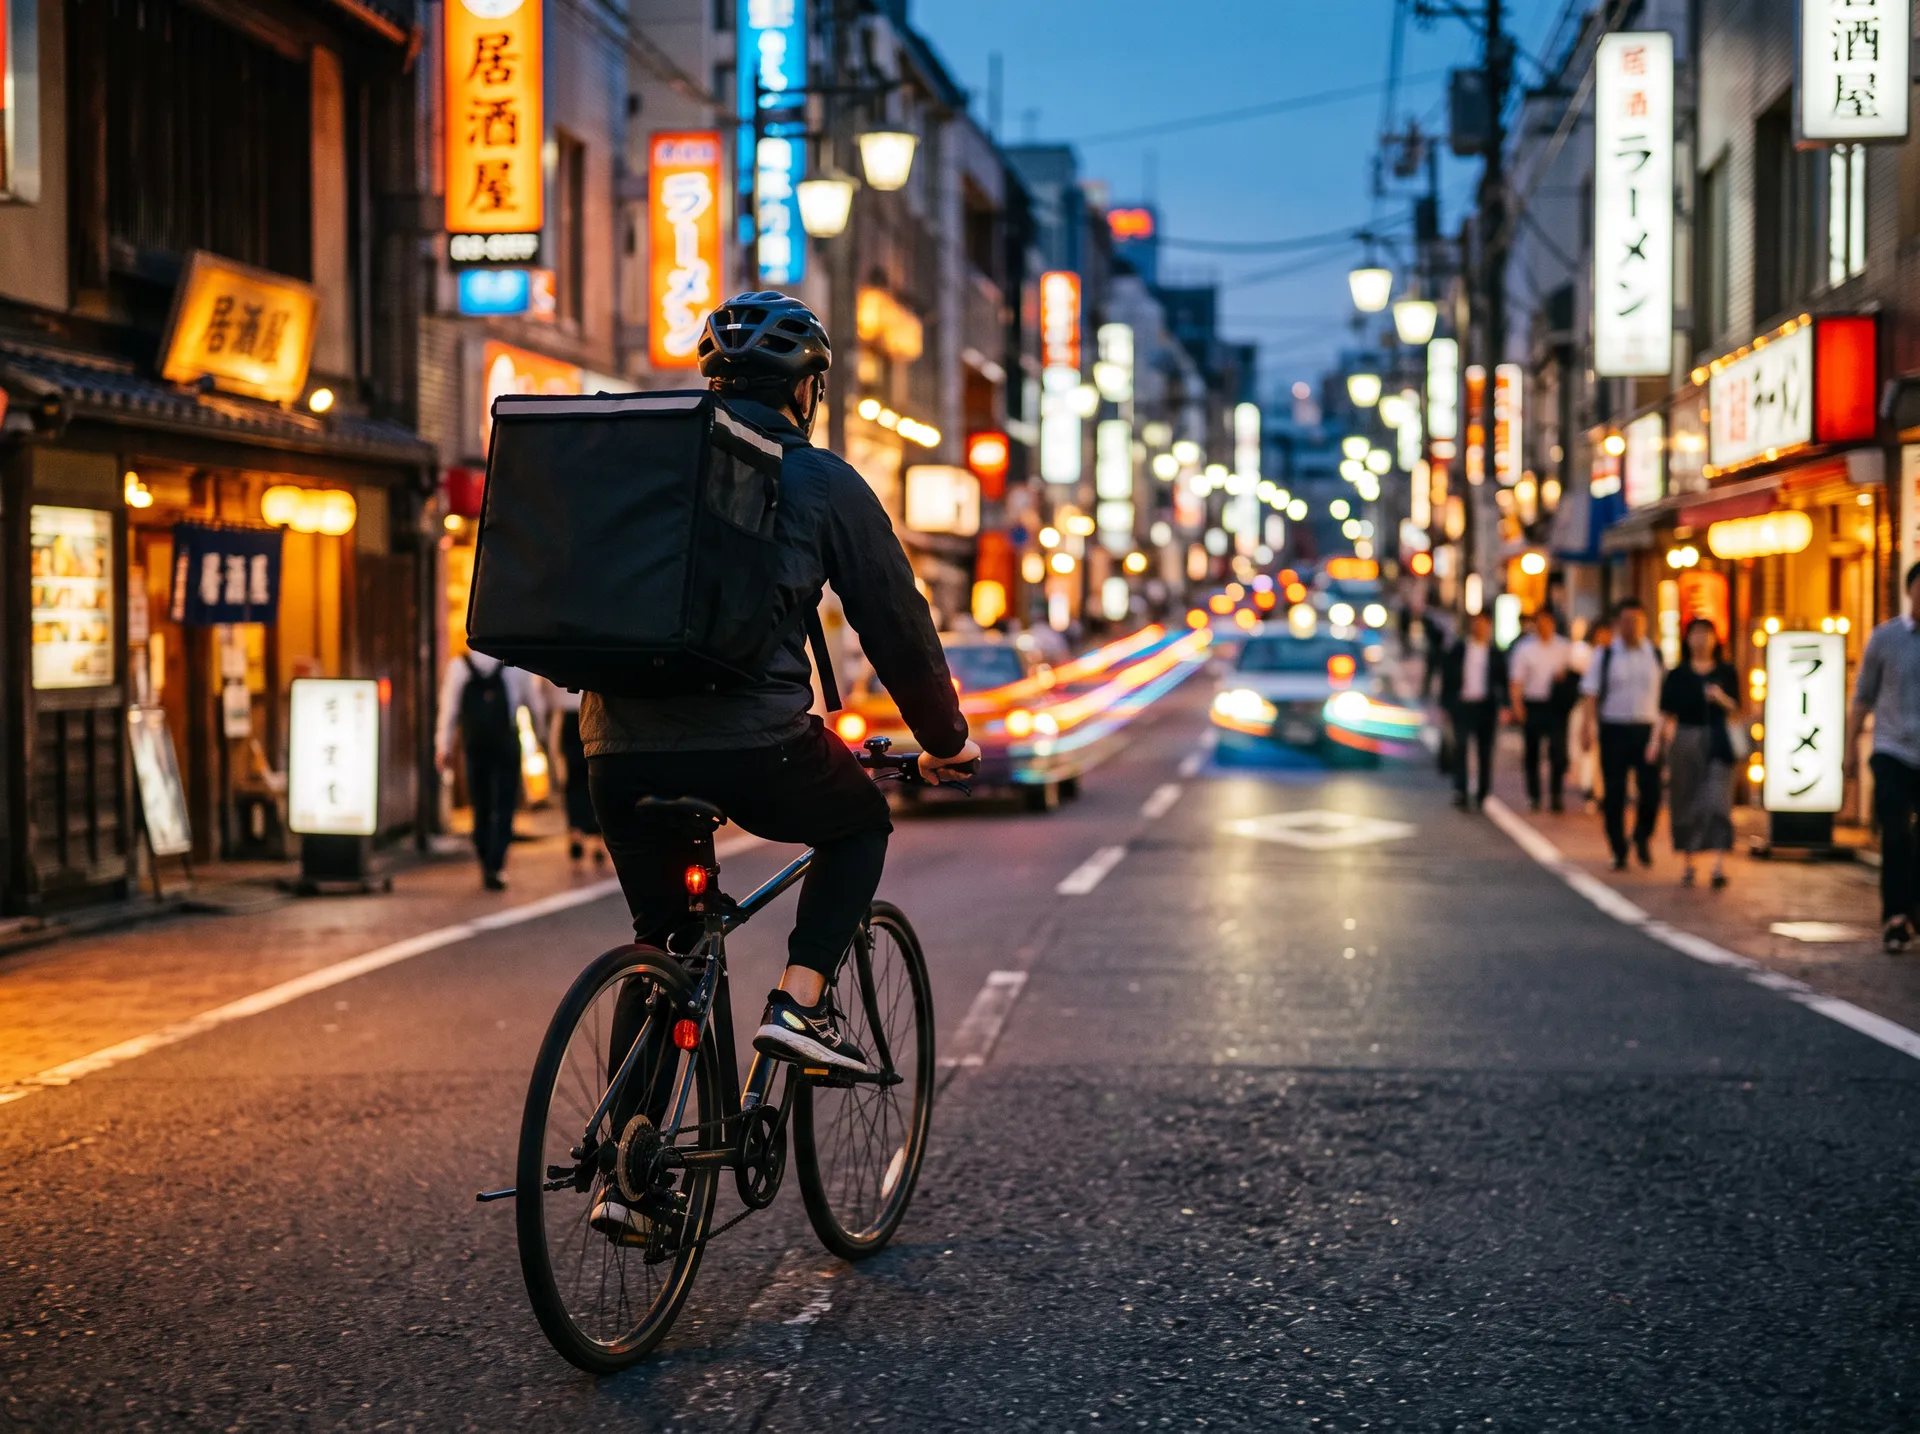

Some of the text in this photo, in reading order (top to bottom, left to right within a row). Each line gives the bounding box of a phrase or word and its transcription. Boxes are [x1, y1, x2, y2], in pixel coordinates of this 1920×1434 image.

[465, 33, 520, 213] 居酒屋
[1830, 0, 1879, 118] 酒屋
[661, 172, 713, 357] ラーメン
[1613, 134, 1652, 317] ラーメン
[1788, 644, 1823, 797] ラーメン
